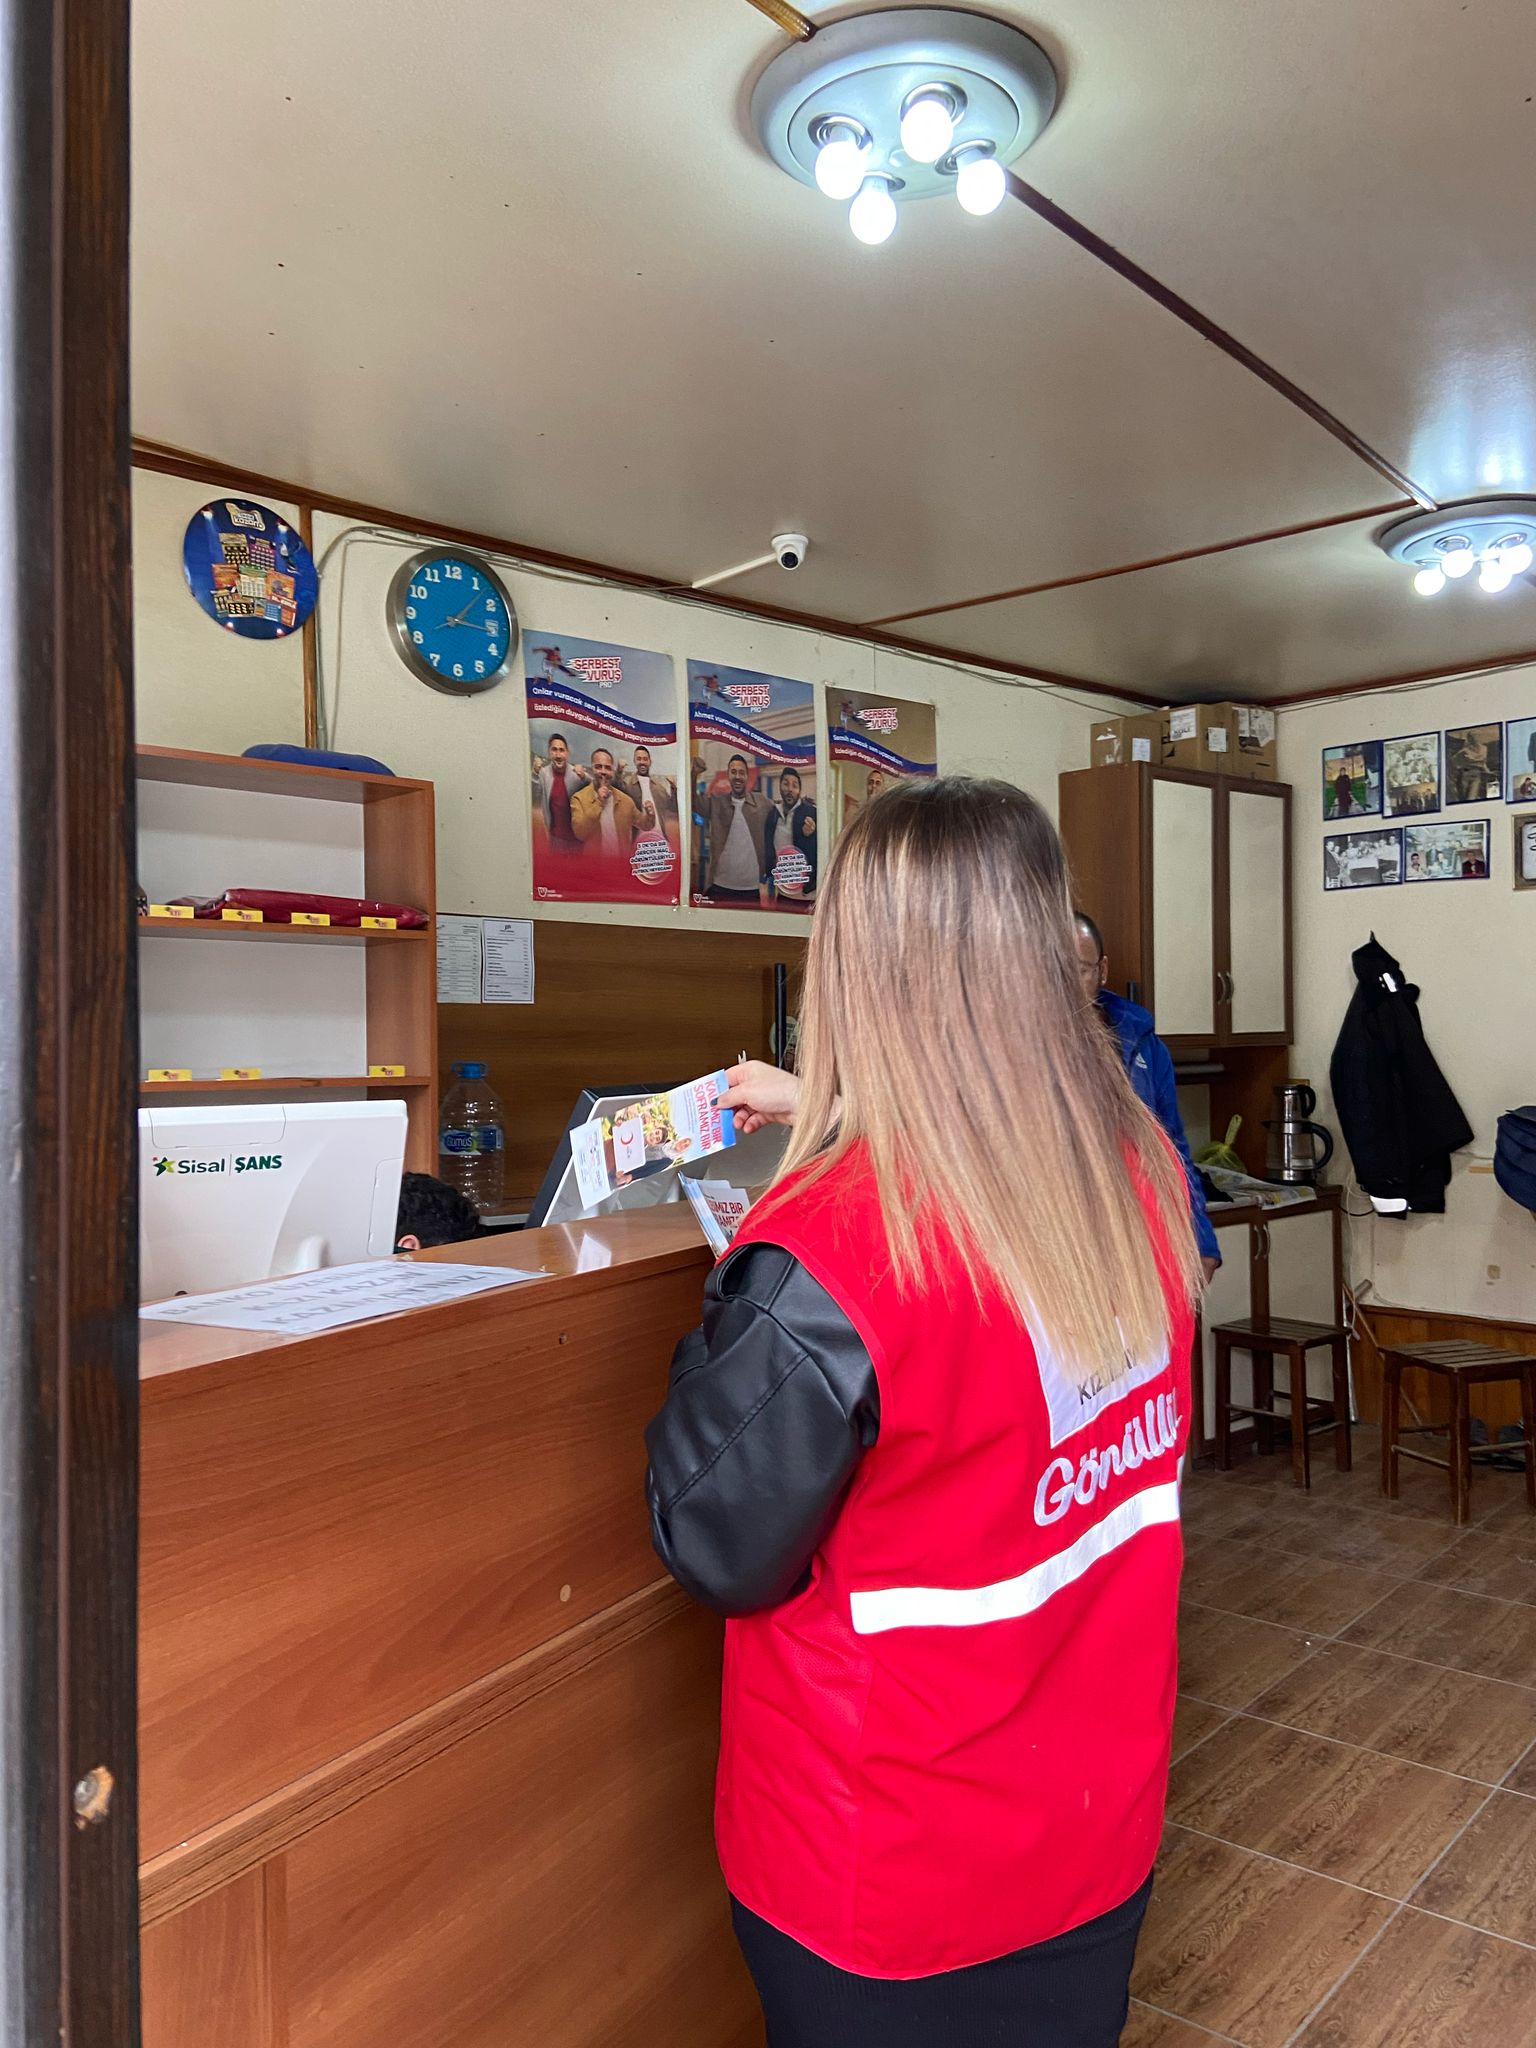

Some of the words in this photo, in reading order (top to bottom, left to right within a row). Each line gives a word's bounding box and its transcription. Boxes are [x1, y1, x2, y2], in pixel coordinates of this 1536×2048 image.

[425, 567, 440, 583] 11
[444, 565, 462, 580] 12
[472, 577, 480, 590] 1
[410, 585, 428, 599] 10
[486, 598, 496, 612] 2
[406, 606, 416, 620] 9
[413, 631, 424, 644] 8
[488, 643, 498, 656] 4
[429, 653, 440, 666] 7
[574, 657, 620, 670] SERBEST
[453, 663, 463, 676] 6
[475, 660, 485, 673] 5
[587, 669, 621, 683] VURUŞ
[730, 684, 769, 696] SERBEST
[554, 691, 583, 706] vuracak
[584, 702, 596, 712] sen
[740, 695, 770, 707] VURUŞ
[863, 709, 896, 720] SERBEST
[598, 722, 624, 737] yeniden
[740, 726, 750, 736] sen
[694, 1084, 710, 1133] SOFRAMIZ
[177, 1158, 225, 1174] Sisal
[234, 1155, 283, 1173] ŞANS
[729, 1202, 745, 1214] BİR
[158, 1290, 273, 1316] BANKO
